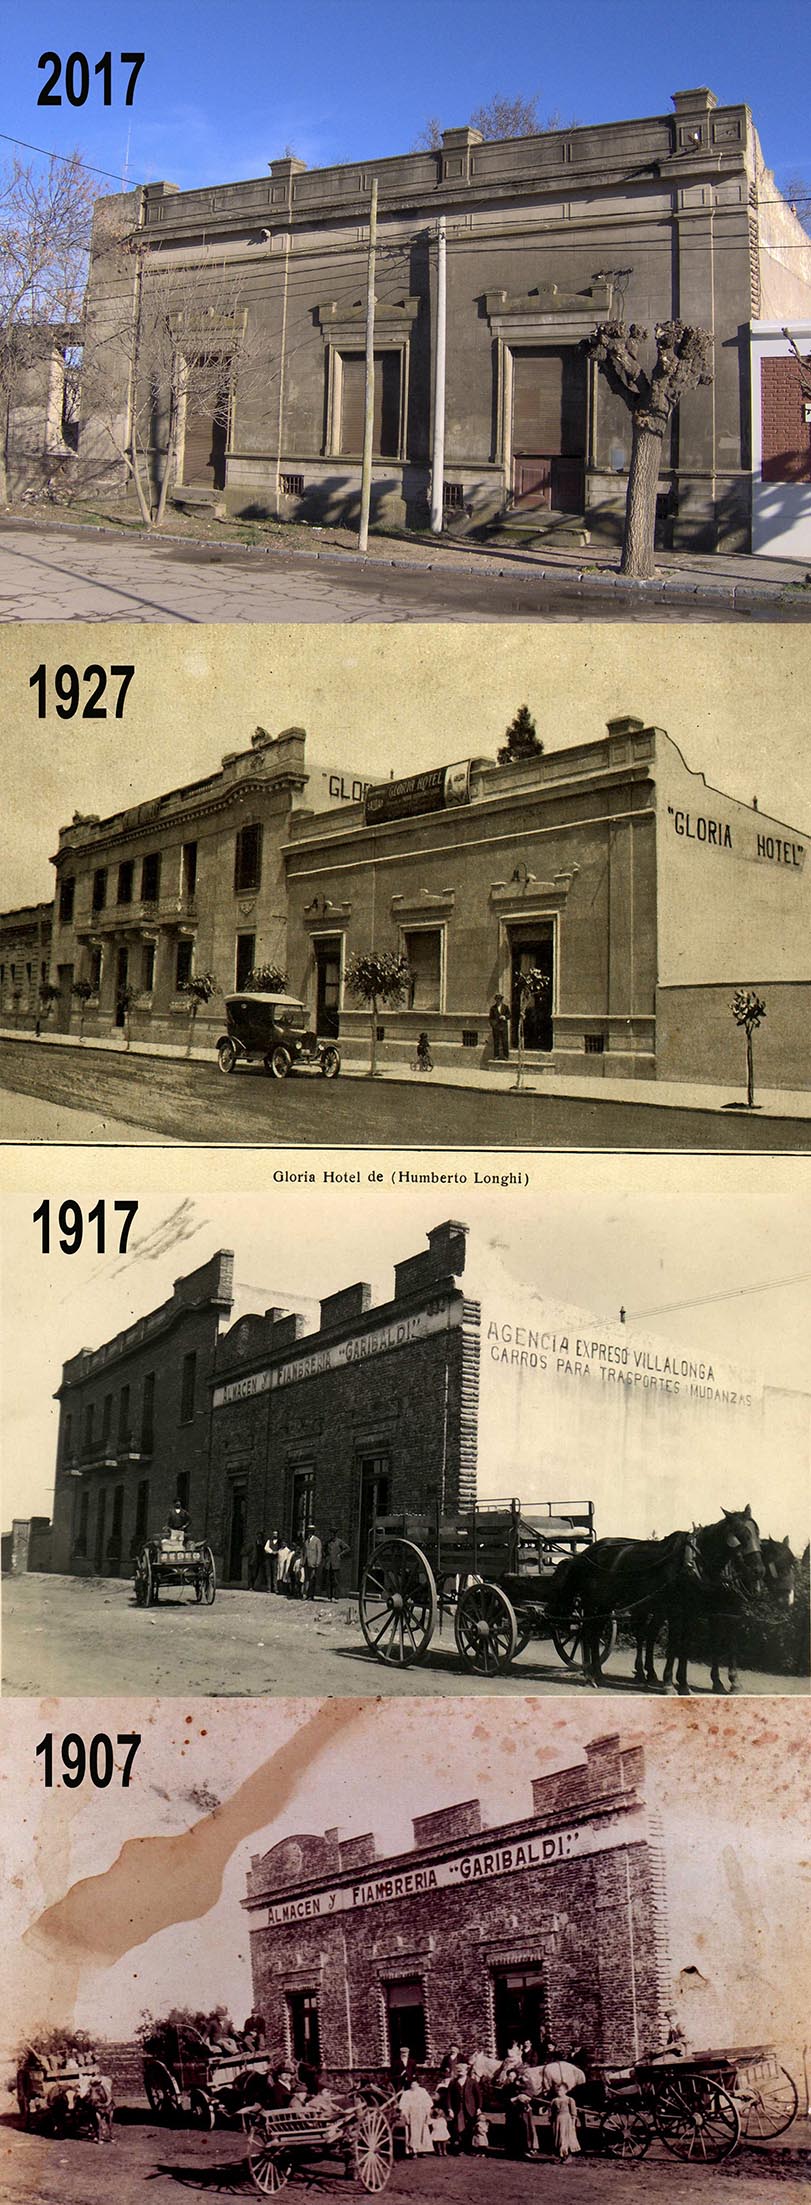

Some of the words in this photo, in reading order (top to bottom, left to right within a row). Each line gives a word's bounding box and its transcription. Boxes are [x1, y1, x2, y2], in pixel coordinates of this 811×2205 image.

[667, 806, 733, 849] "GLORIA
[756, 833, 804, 866] HOTEL"
[272, 1170, 316, 1184] Gloria
[323, 1171, 361, 1184] Hotel
[367, 1170, 384, 1183] de
[391, 1170, 467, 1185] (Humberto
[473, 1171, 529, 1188] Longhi)
[487, 1321, 569, 1355] AGENCIA
[575, 1339, 628, 1365] EXPRESO
[633, 1350, 716, 1382] VILLALONGA
[490, 1345, 548, 1370] CARROS
[556, 1358, 591, 1377] PARA
[600, 1366, 680, 1394] TRASPORTES
[689, 1383, 752, 1407] MUDANZAS
[222, 1377, 258, 1401] ALMACEN
[267, 1898, 321, 1925] ALMACEN
[352, 1869, 438, 1906] FIAMBRERIA
